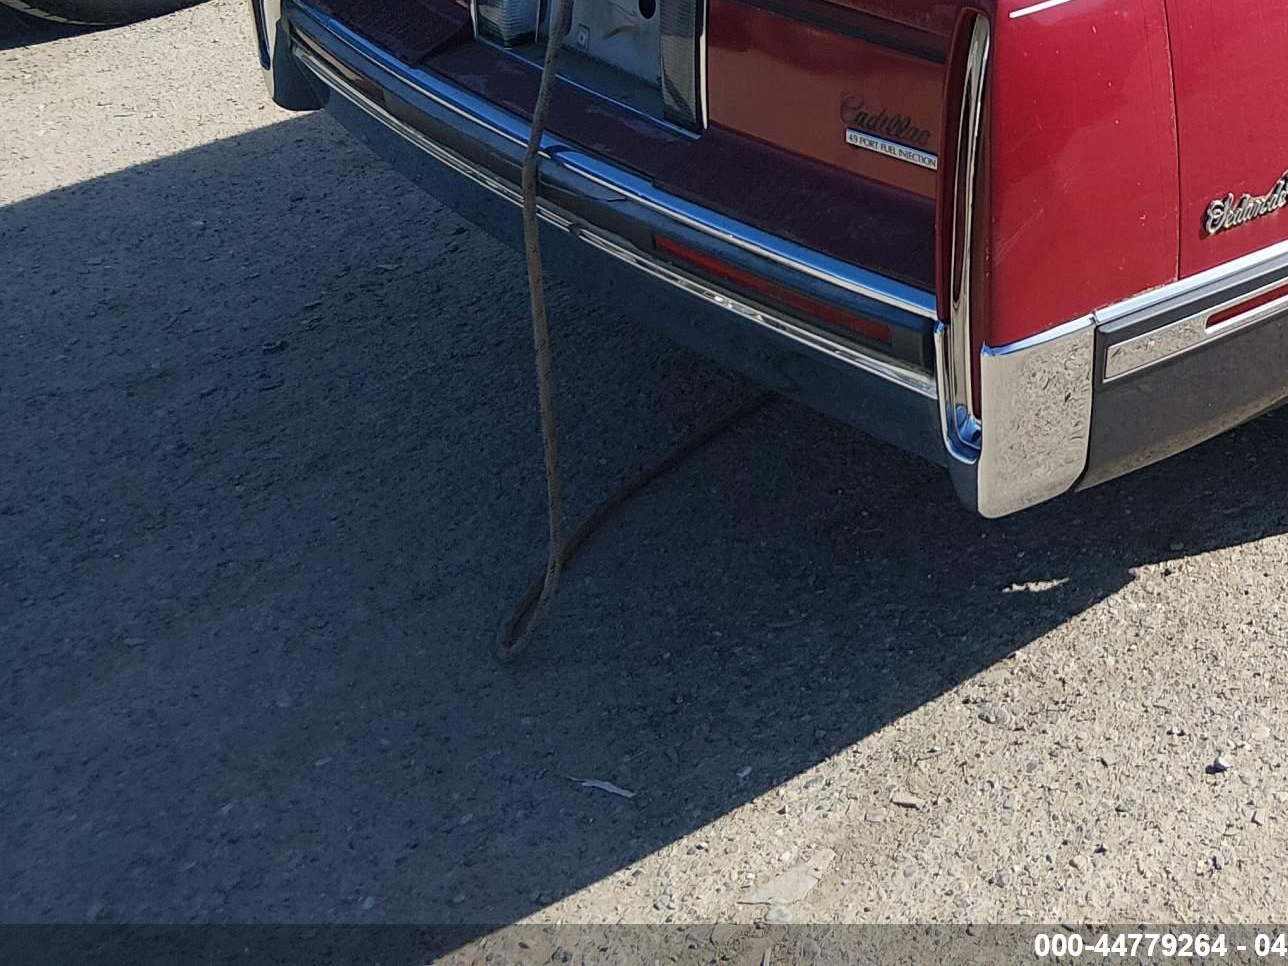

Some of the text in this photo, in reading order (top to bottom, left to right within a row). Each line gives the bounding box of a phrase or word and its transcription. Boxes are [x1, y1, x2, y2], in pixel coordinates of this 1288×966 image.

[841, 96, 930, 146] Cadillac
[859, 137, 879, 150] PORT
[880, 143, 897, 155] FUEL
[898, 149, 937, 168] INJECTION
